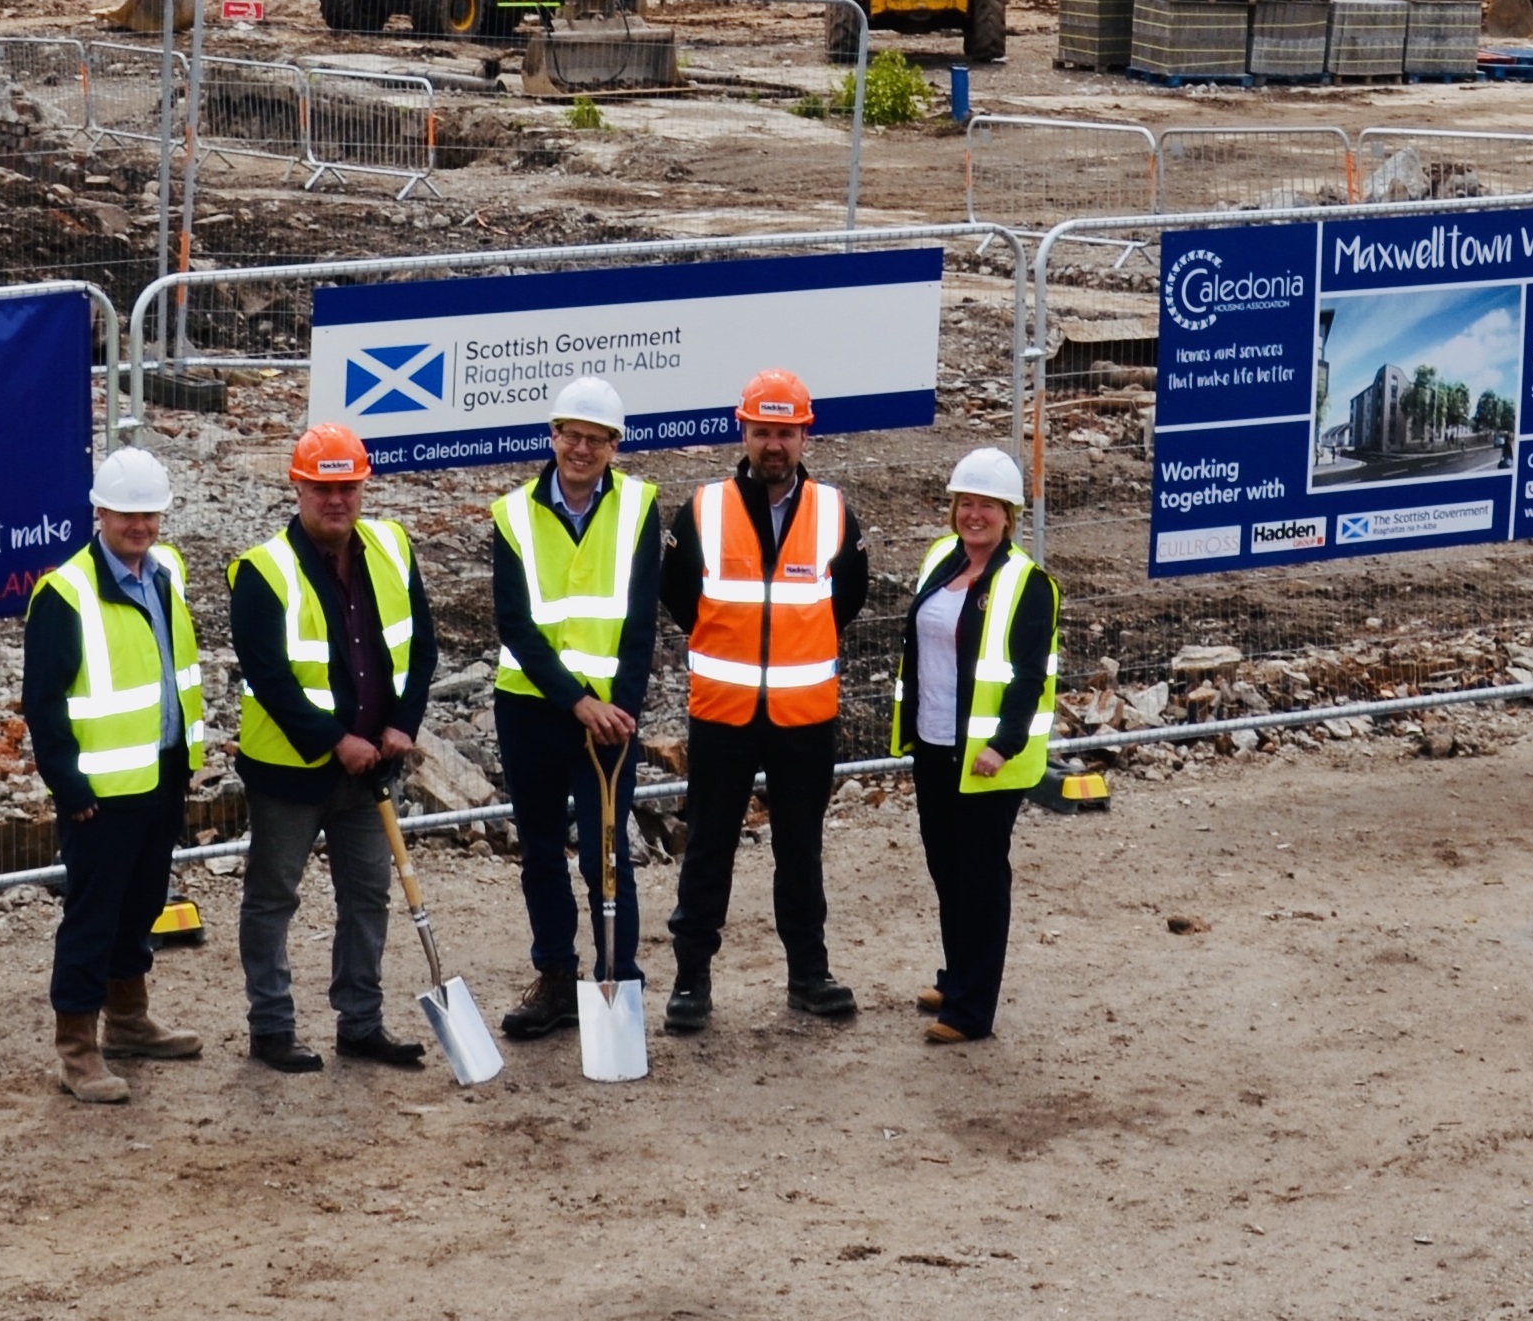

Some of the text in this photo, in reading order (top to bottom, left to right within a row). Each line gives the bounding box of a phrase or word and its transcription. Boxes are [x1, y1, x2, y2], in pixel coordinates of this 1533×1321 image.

[1181, 268, 1304, 313] Caledonia
[1214, 300, 1290, 313] HOUSING ASSOCIATION
[466, 327, 682, 360] Scottish Government
[1176, 342, 1283, 363] Homes and services
[465, 351, 681, 387] Riaghaltas na h-Alba
[1168, 365, 1295, 391] that make life better
[463, 383, 549, 412] gov.scot
[366, 446, 408, 465] ntact:
[413, 439, 493, 461] Caledonia
[498, 433, 553, 454] Housin
[658, 420, 696, 438] 0800
[700, 417, 728, 434] 678
[1161, 458, 1239, 482] Working
[1159, 477, 1285, 512] together with
[1373, 505, 1489, 526] The Scottish Government
[11, 514, 72, 550] make
[1253, 521, 1316, 543] Hadden
[1293, 537, 1316, 548] GROUP
[1157, 534, 1239, 559] CULLROSS
